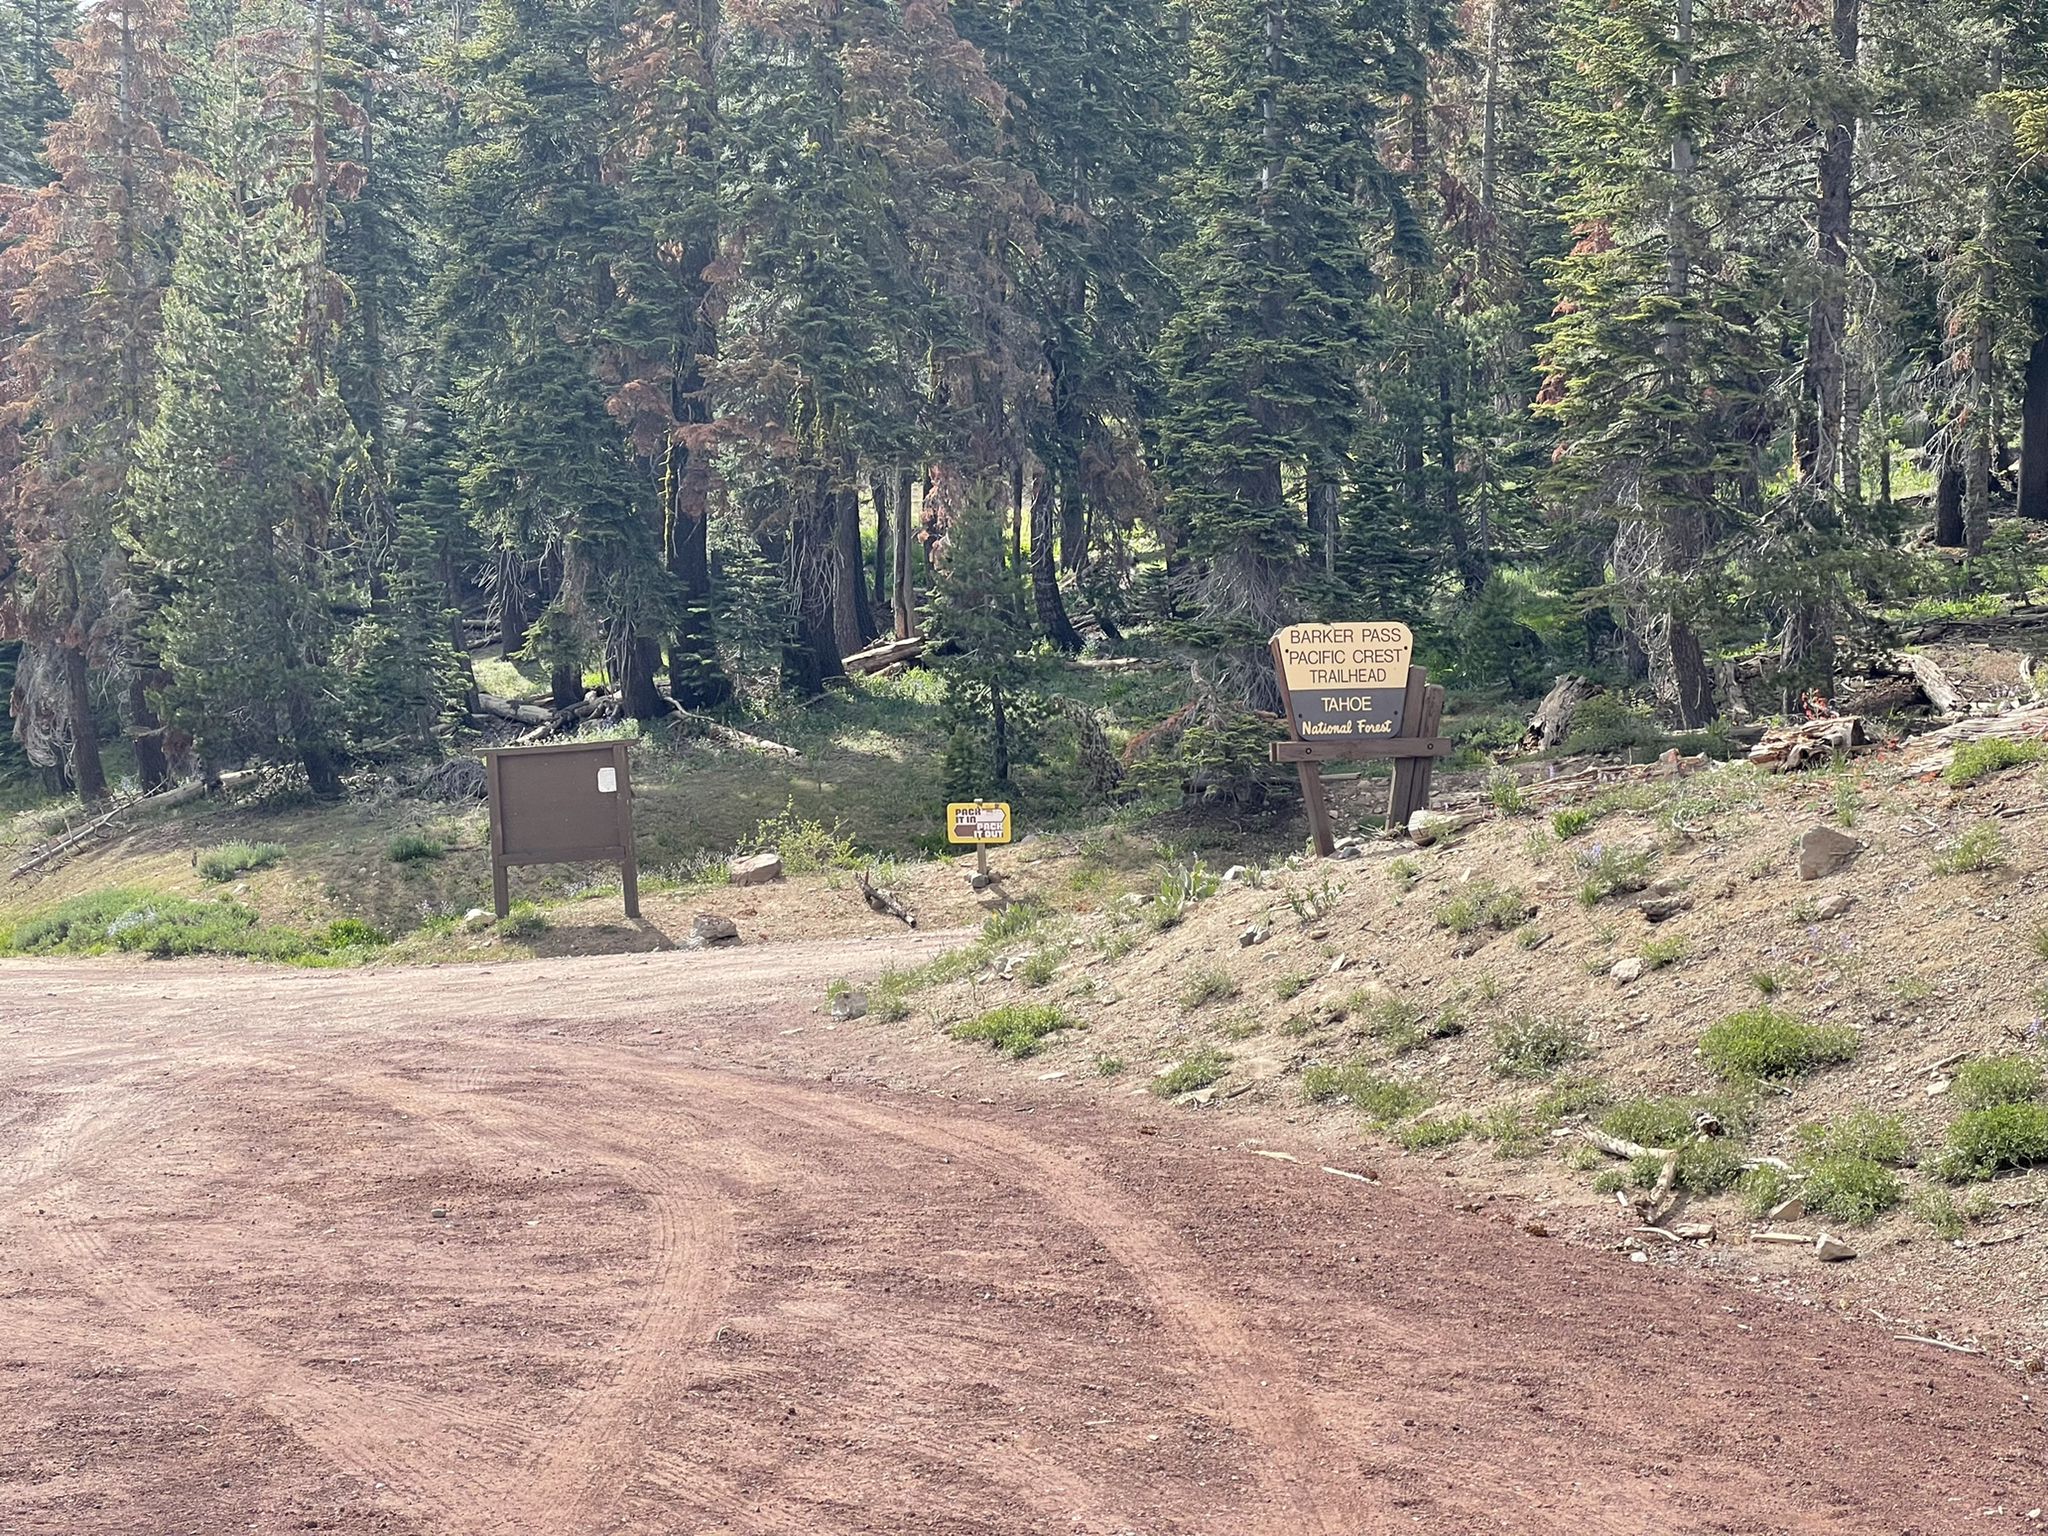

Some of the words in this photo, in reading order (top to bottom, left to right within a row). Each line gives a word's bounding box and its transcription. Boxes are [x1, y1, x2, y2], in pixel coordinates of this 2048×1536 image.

[1290, 629, 1354, 644] BARKER
[1362, 628, 1401, 643] PASS
[1289, 650, 1346, 665] PACIFIC
[1352, 649, 1403, 664] CREST
[1309, 669, 1387, 684] TRAILHEAD
[1321, 696, 1372, 712] TAHOE
[1302, 719, 1353, 735] National
[1356, 719, 1393, 734] Forest
